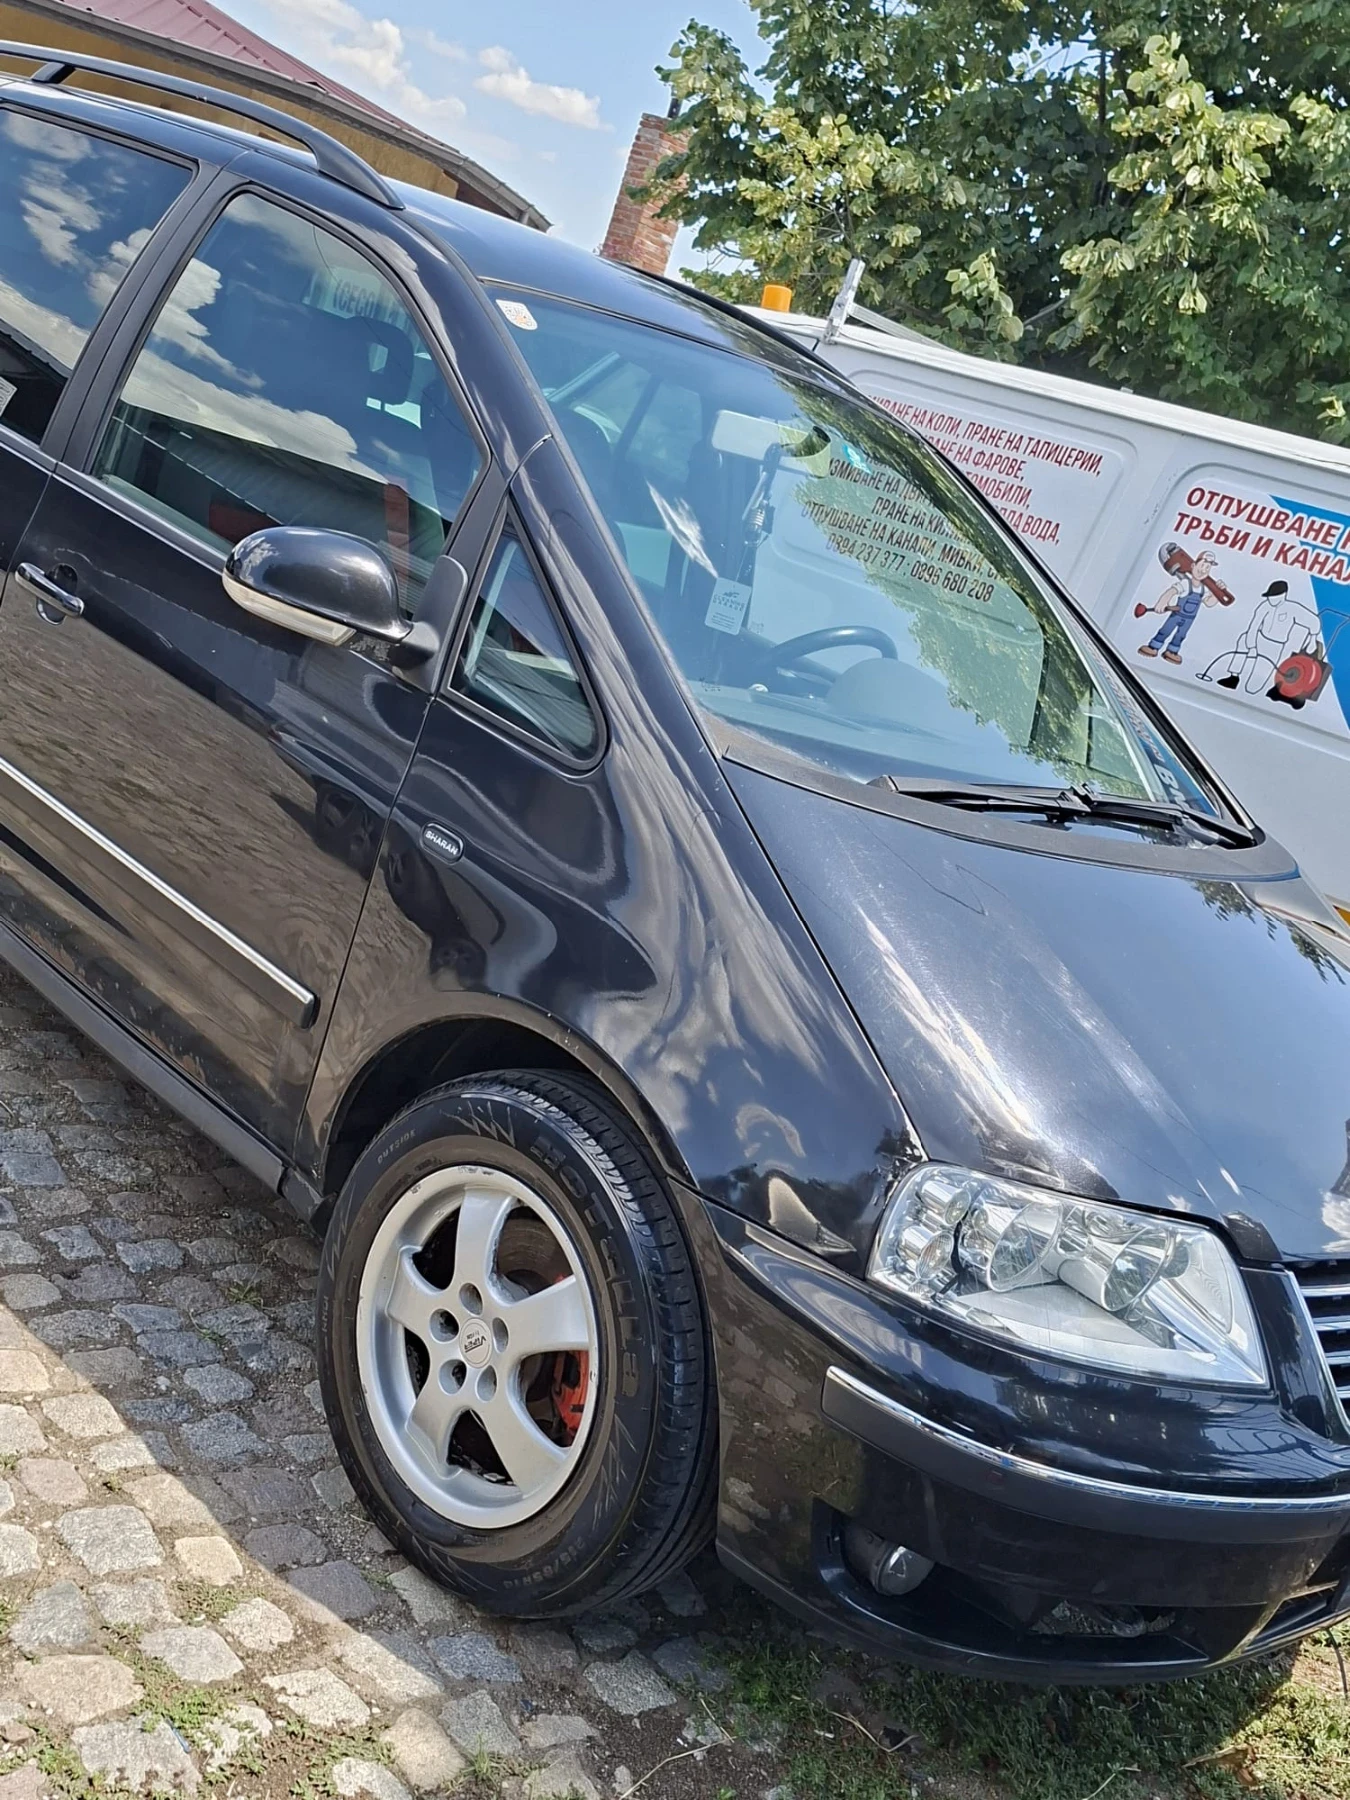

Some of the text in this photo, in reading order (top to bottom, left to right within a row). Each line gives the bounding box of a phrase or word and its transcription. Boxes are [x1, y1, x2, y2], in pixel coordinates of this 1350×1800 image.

[910, 407, 928, 428] НА
[925, 411, 962, 439] КОЛИ,
[962, 421, 1007, 448] ПРАНЕ
[1002, 431, 1024, 454] НА
[1022, 436, 1103, 477] ТАПИЦЕРИИ,
[952, 443, 973, 465] НА
[972, 449, 1027, 482] ФАРОВЕ,
[868, 521, 887, 542] НА
[871, 496, 913, 524] ПРАНЕ
[909, 508, 926, 529] НА
[1021, 515, 1060, 546] ВОДА,
[1187, 487, 1340, 545] ОТПУШВАНЕ
[1173, 512, 1250, 551] ТРЪБИ
[1250, 535, 1273, 559] И
[856, 542, 881, 564] 237
[880, 550, 906, 571] 377
[942, 570, 969, 594] 680
[967, 578, 995, 602] 208
[425, 830, 459, 855] SHARAN
